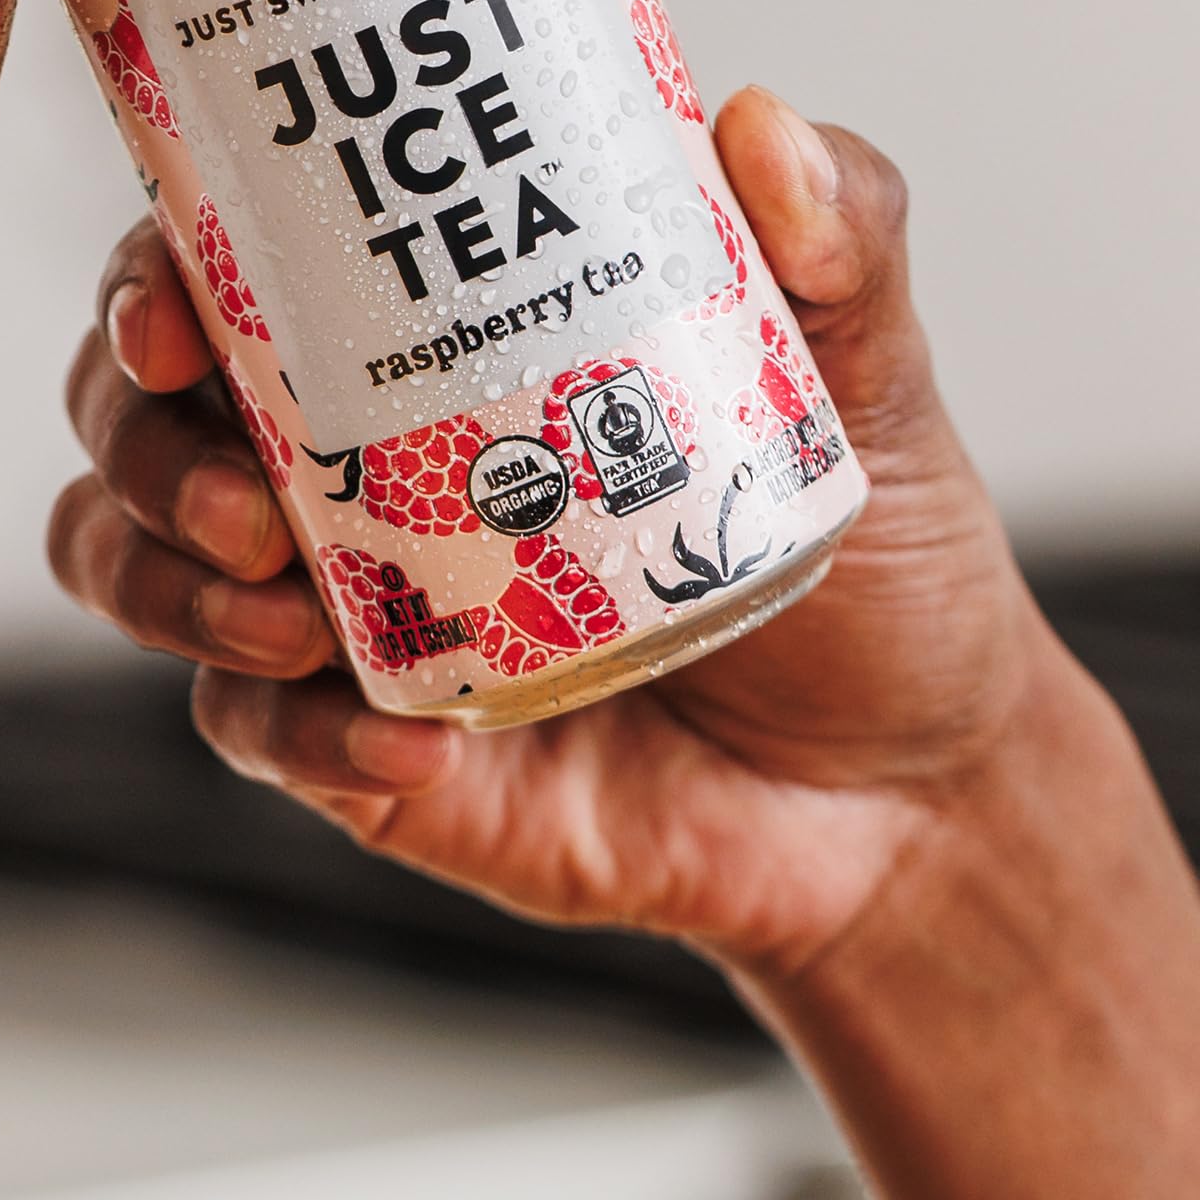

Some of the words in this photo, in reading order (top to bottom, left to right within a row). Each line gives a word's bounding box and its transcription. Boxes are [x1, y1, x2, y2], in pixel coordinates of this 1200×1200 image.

[333, 71, 535, 219] ICE
[364, 280, 575, 387] raspberry
[582, 251, 646, 297] tea
[480, 454, 543, 491] USDA
[603, 458, 631, 481] FAIR
[630, 441, 669, 467] TRADE
[489, 479, 559, 517] ORGANIC
[634, 478, 662, 499] TEA
[382, 597, 411, 628] NET
[373, 633, 393, 662] 12
[400, 628, 423, 657] OZ
